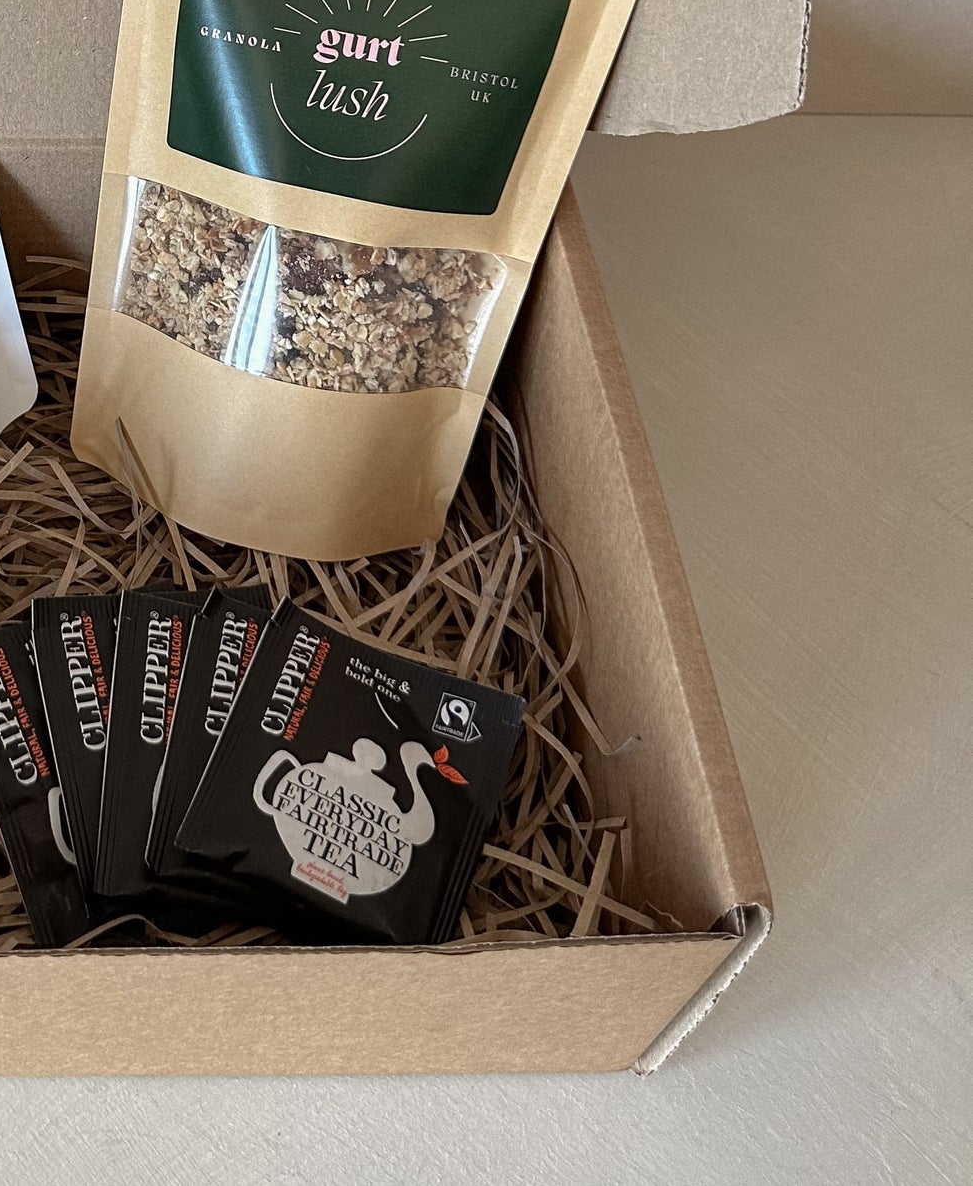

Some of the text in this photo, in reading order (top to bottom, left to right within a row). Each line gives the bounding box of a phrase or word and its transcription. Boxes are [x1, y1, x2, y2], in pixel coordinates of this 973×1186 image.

[200, 26, 283, 52] GRANOLA
[313, 28, 405, 66] gurt
[305, 69, 391, 121] lush
[449, 66, 519, 89] BRISTOL
[470, 90, 492, 104] UK
[82, 615, 101, 665] DELICIOUS
[170, 619, 183, 668] DELICIOUS
[93, 666, 103, 674] &
[96, 675, 108, 698] FAIR
[168, 678, 179, 699] FAIR
[298, 685, 313, 705] FAIR
[308, 640, 331, 680] DELICIOUS
[345, 666, 402, 703] bold one
[349, 657, 411, 694] the big &
[17, 706, 32, 729] FAIR
[435, 723, 465, 739] FAIRTRADE
[281, 779, 409, 858] EVERYDAY
[297, 768, 401, 834] CLASSIC
[274, 794, 404, 876] FAIRTRADE
[302, 828, 359, 879] TEA
